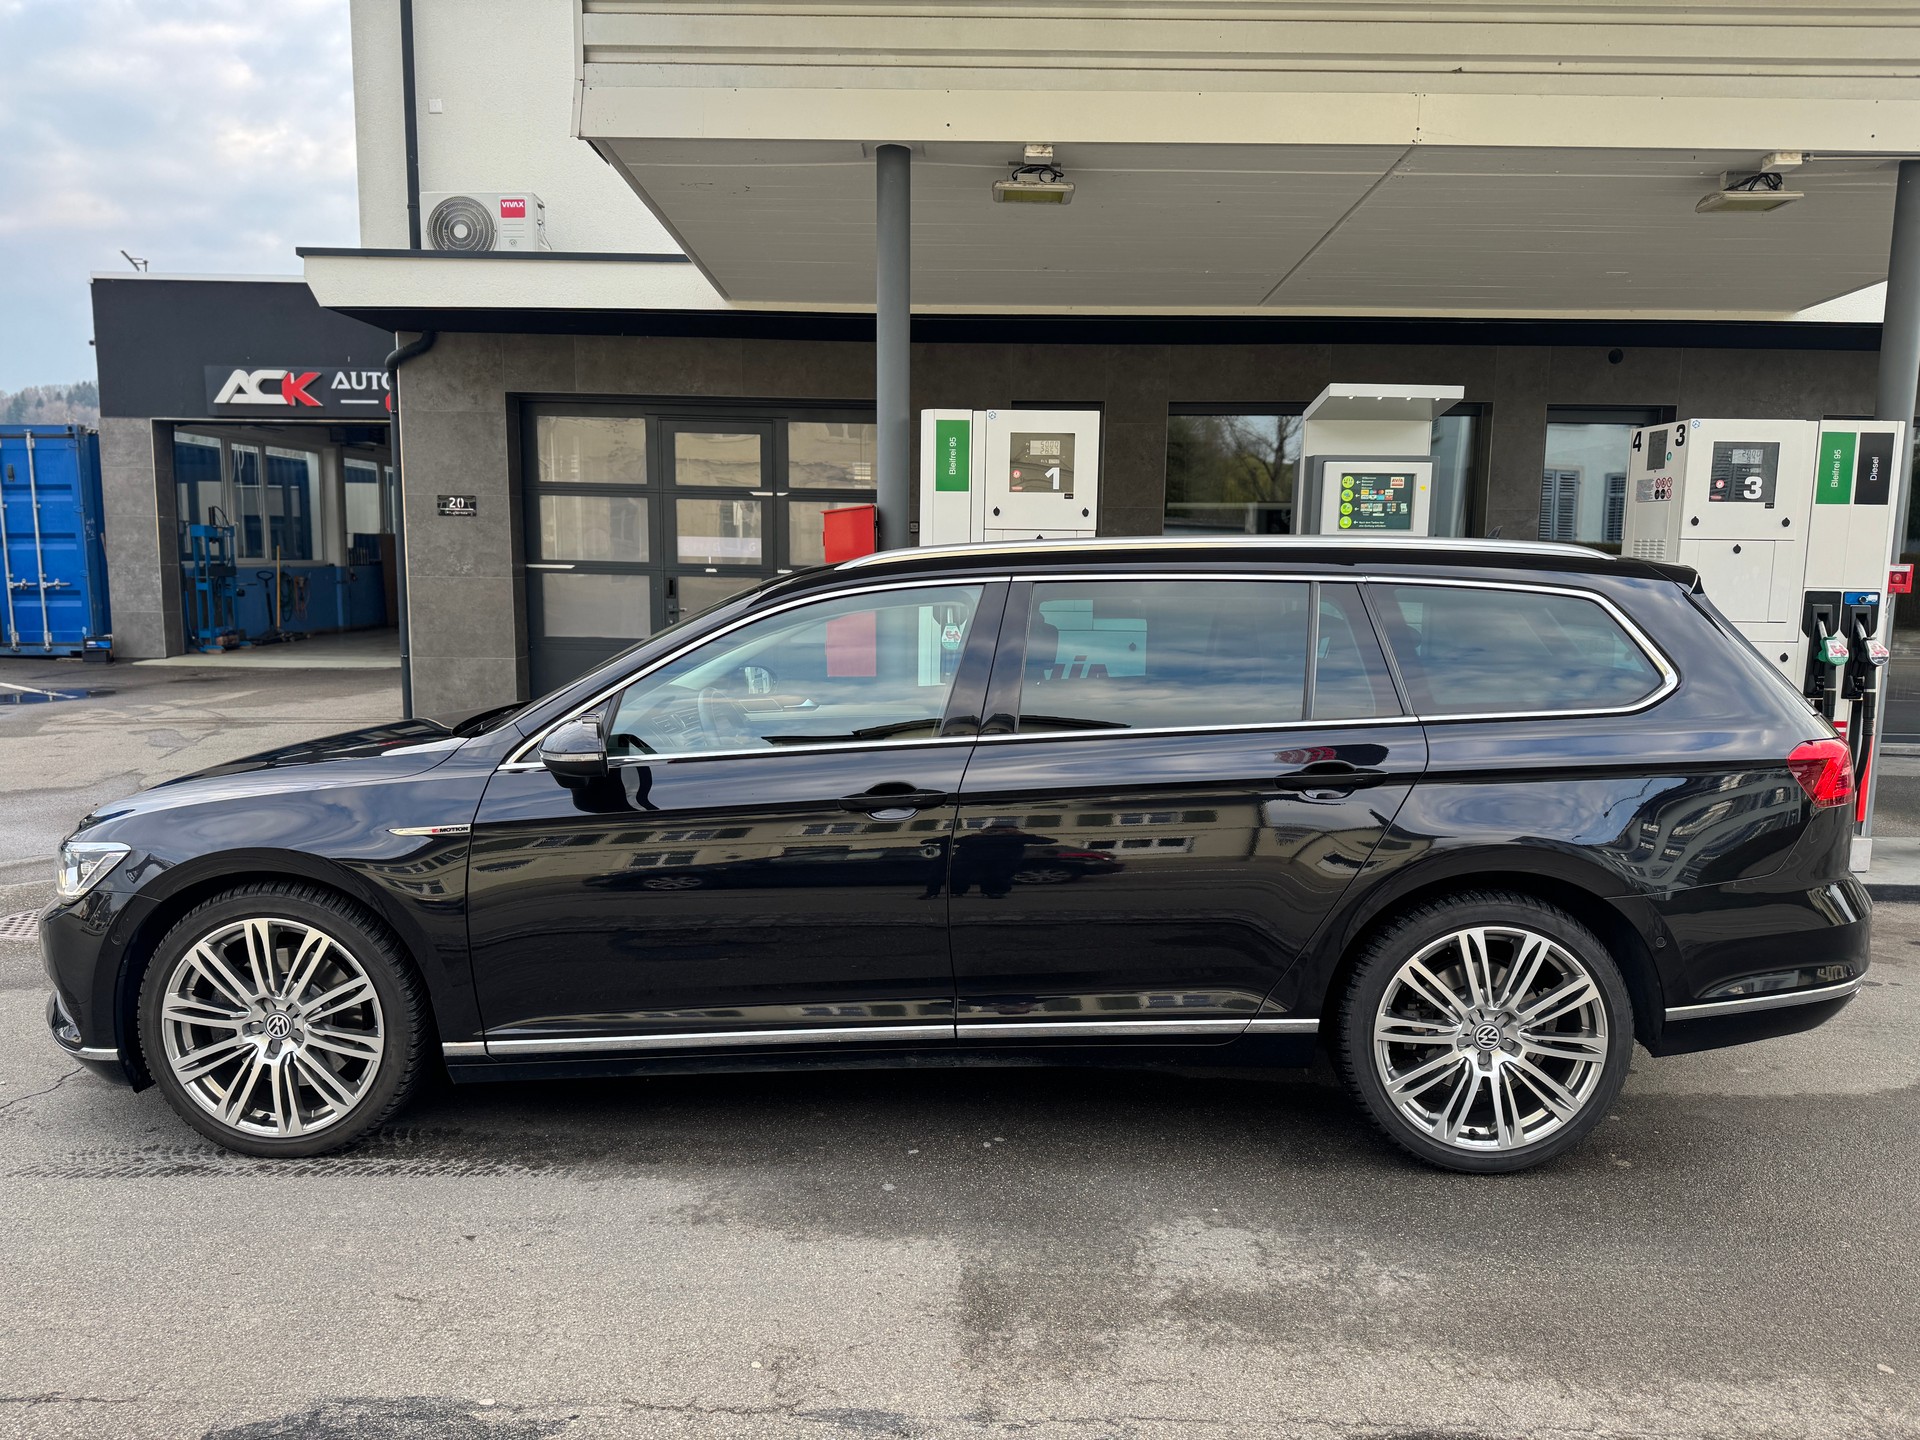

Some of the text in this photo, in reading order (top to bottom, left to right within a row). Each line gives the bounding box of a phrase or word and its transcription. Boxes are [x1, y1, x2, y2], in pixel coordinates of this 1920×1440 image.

[213, 369, 323, 406] ACK
[1632, 431, 1642, 452] 4
[1675, 424, 1686, 447] 3
[949, 436, 957, 475] Bleifrei 95
[1045, 467, 1060, 490] 1
[1831, 449, 1842, 488] Bleifrei 95
[1869, 456, 1880, 481] Diesel
[1743, 476, 1763, 499] 3
[449, 497, 464, 508] 20
